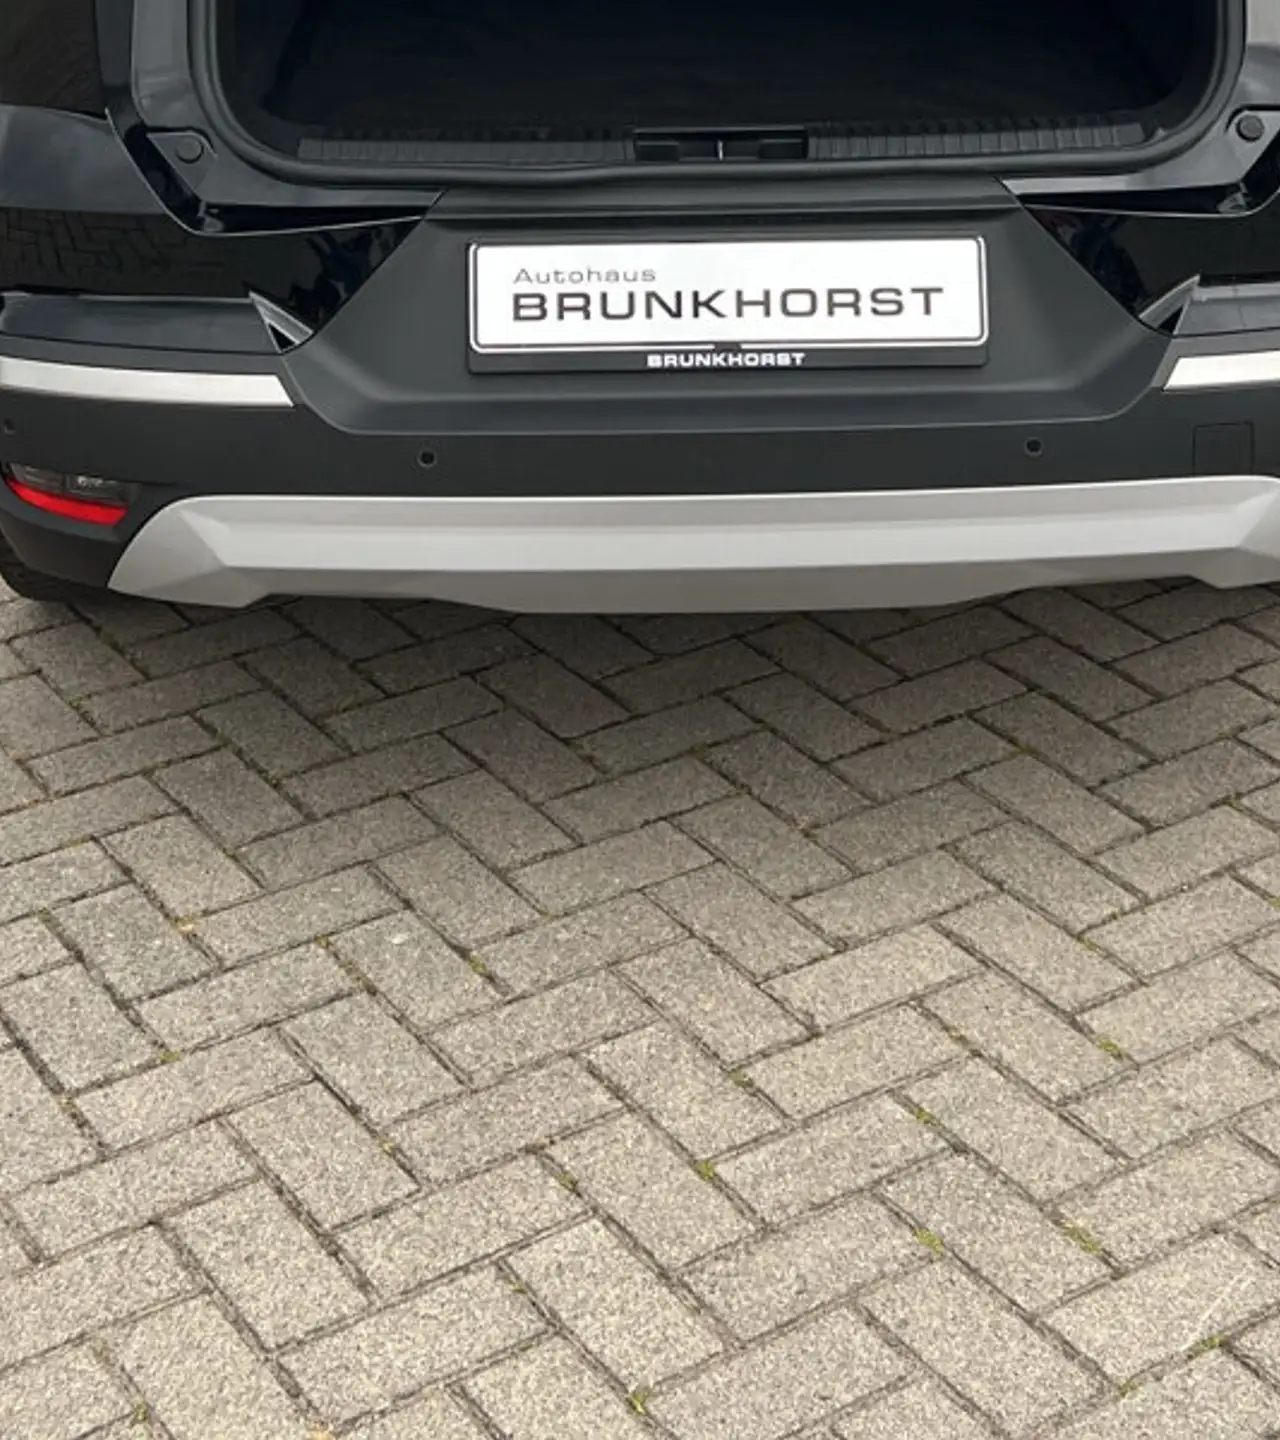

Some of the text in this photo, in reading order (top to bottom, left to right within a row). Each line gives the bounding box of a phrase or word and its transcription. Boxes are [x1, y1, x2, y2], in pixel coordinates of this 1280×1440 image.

[513, 267, 656, 285] Autohaus
[512, 287, 943, 322] BRUNKHORST
[646, 353, 806, 368] BRUNKHORST
